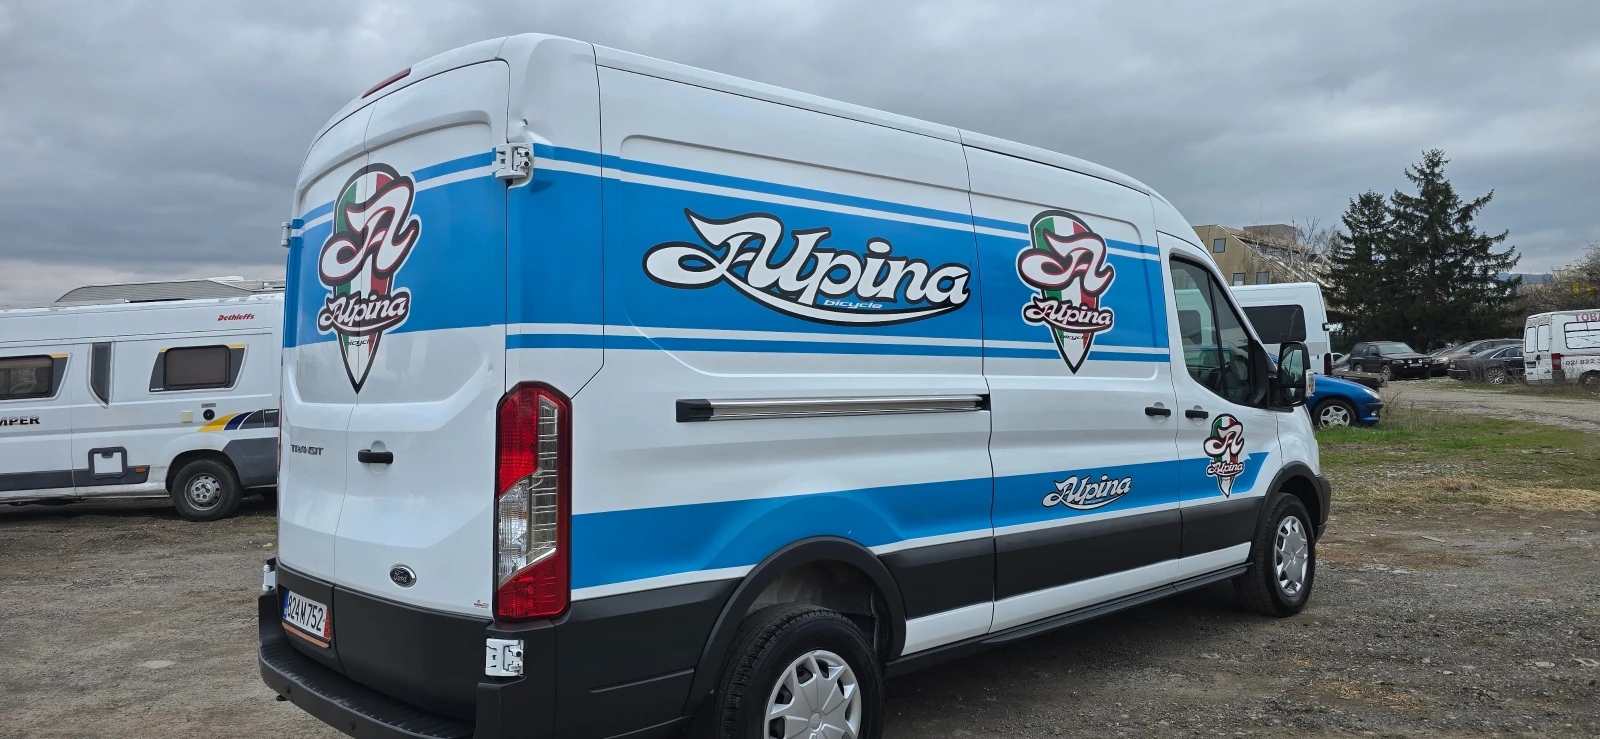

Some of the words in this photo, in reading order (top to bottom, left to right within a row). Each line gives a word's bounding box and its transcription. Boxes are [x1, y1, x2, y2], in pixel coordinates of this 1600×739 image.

[643, 209, 970, 326] Alpina
[824, 299, 882, 309] bicycle
[217, 313, 255, 321] Dethleffs
[318, 294, 408, 331] Alpina
[1024, 298, 1112, 331] Alpina
[1574, 312, 1600, 322] ТОВ
[291, 444, 324, 456] TRANSIT
[1207, 461, 1244, 476] Alpina
[1042, 474, 1132, 510] Alpina
